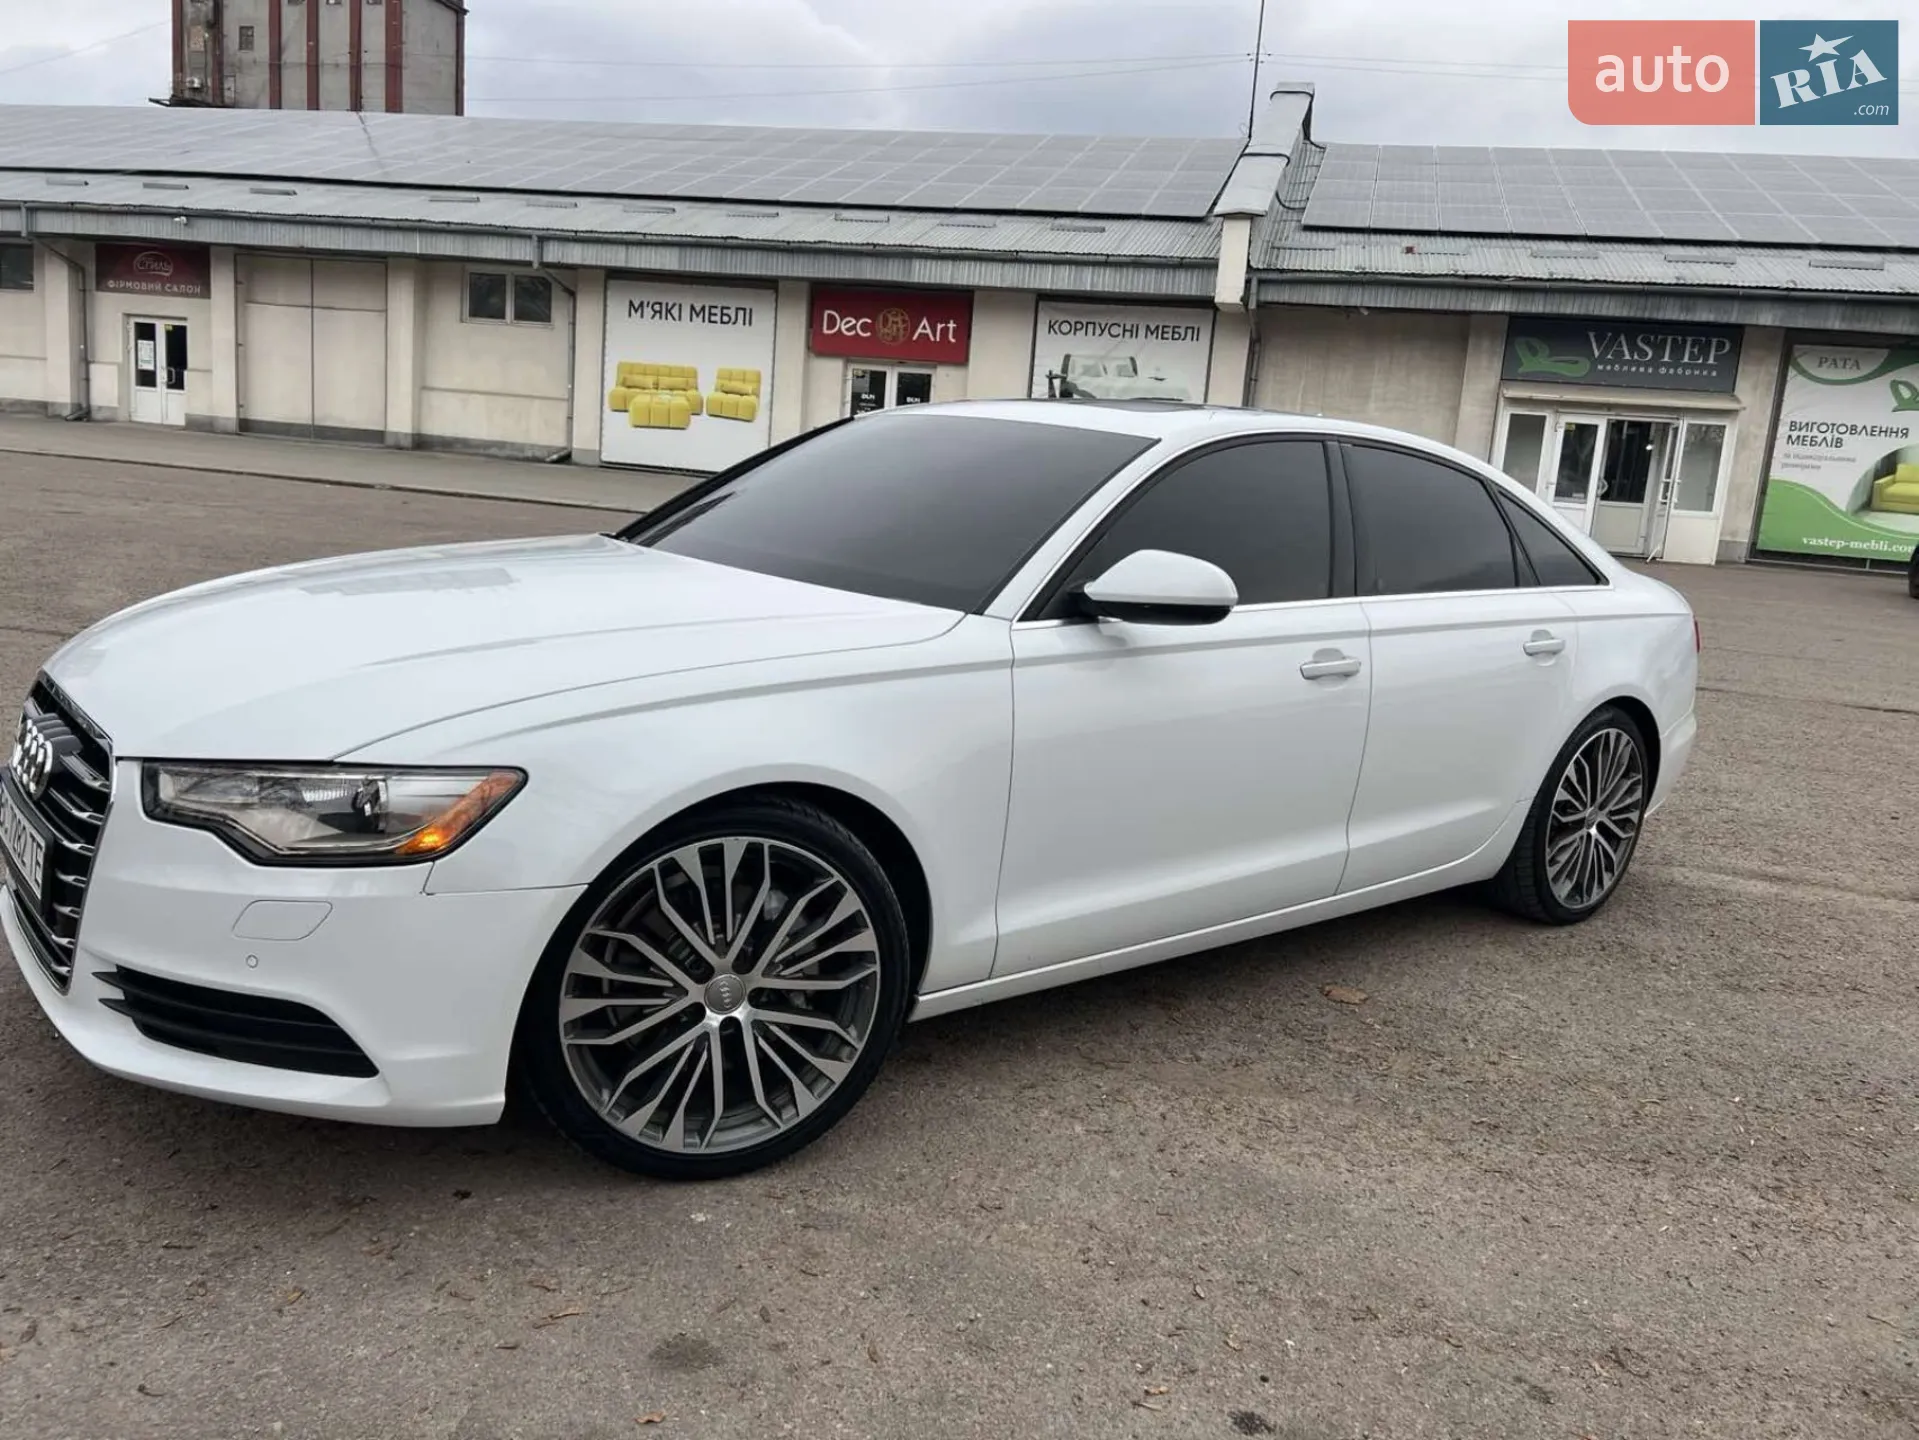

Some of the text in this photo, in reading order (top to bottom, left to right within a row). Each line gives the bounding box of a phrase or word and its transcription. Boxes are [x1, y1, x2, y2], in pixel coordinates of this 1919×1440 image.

[164, 283, 201, 294] САЛОН
[628, 299, 753, 327] М'ЯКІ МЕБЛІ
[822, 310, 957, 343] Dec Art
[1048, 319, 1200, 342] КОРПУСНІ МЕБЛІ
[1587, 331, 1731, 365] VASTEP
[1786, 434, 1844, 448] МЕБЛІВ
[1788, 420, 1910, 439] ВИГОТОВЛЕННЯ
